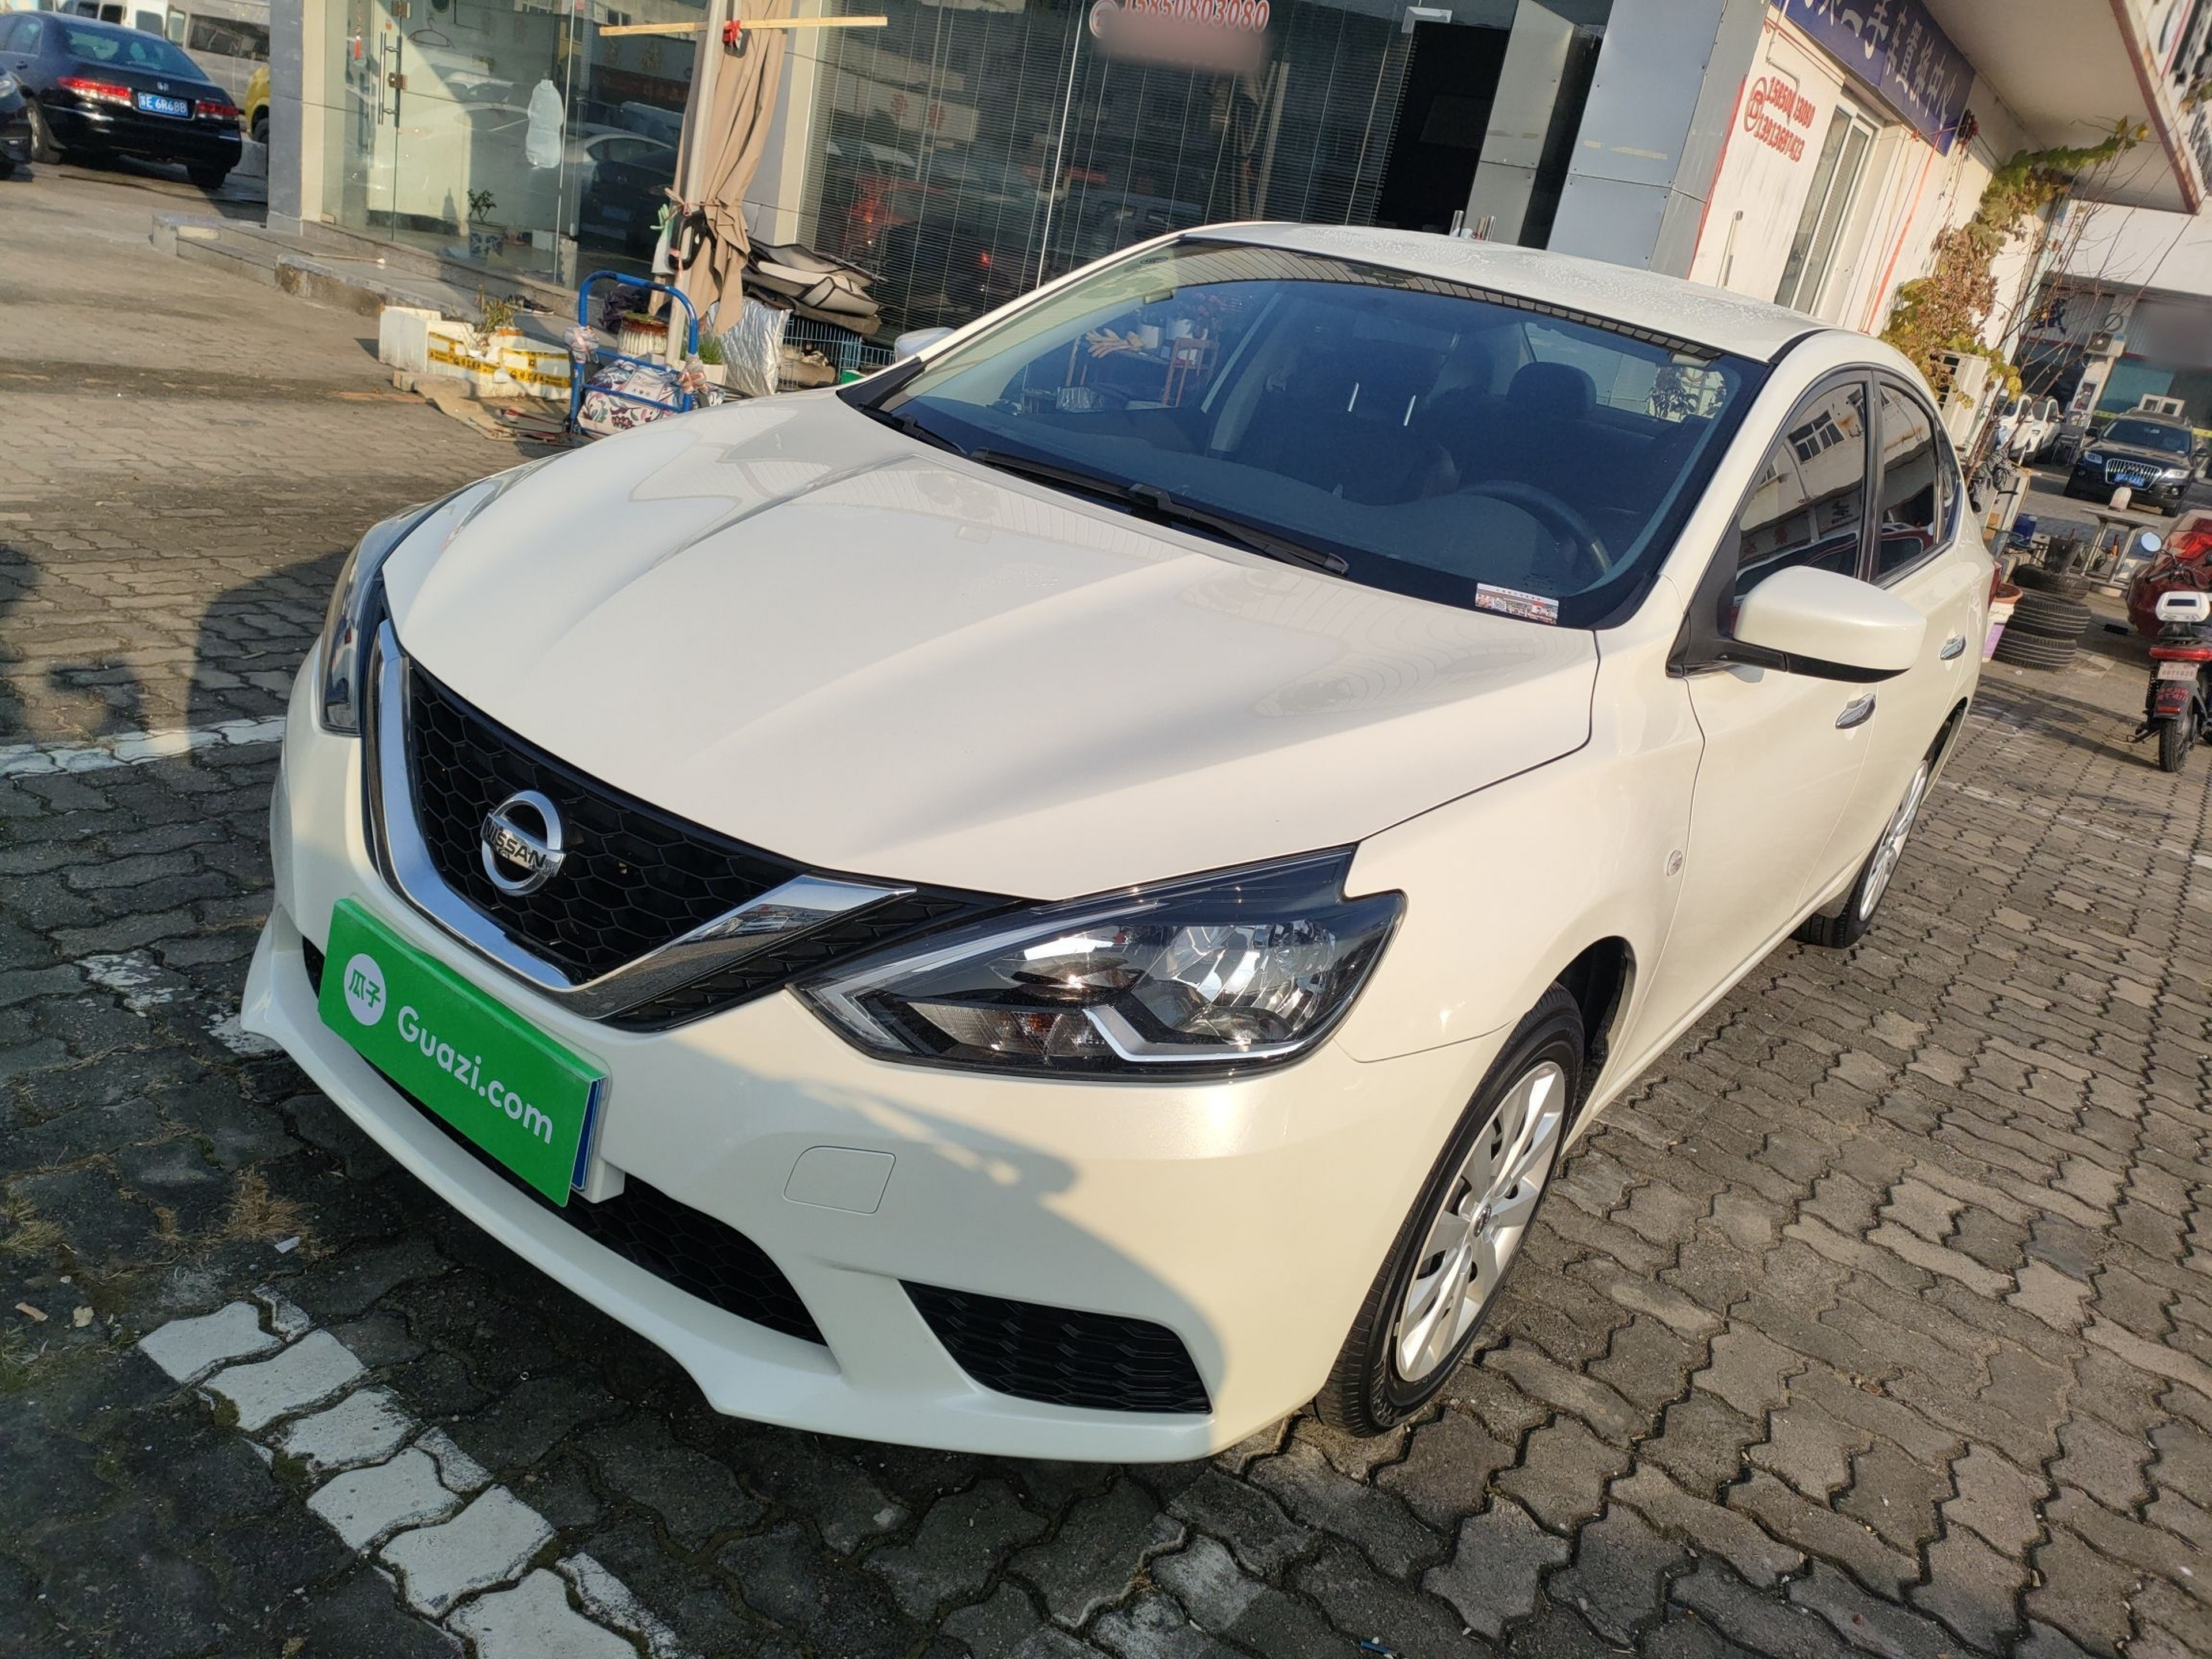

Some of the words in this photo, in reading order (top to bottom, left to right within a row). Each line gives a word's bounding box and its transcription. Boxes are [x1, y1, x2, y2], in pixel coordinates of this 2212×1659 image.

[485, 819, 547, 868] NISSAN
[348, 968, 381, 1009] 瓜子
[397, 1006, 554, 1145] Guazi.com
